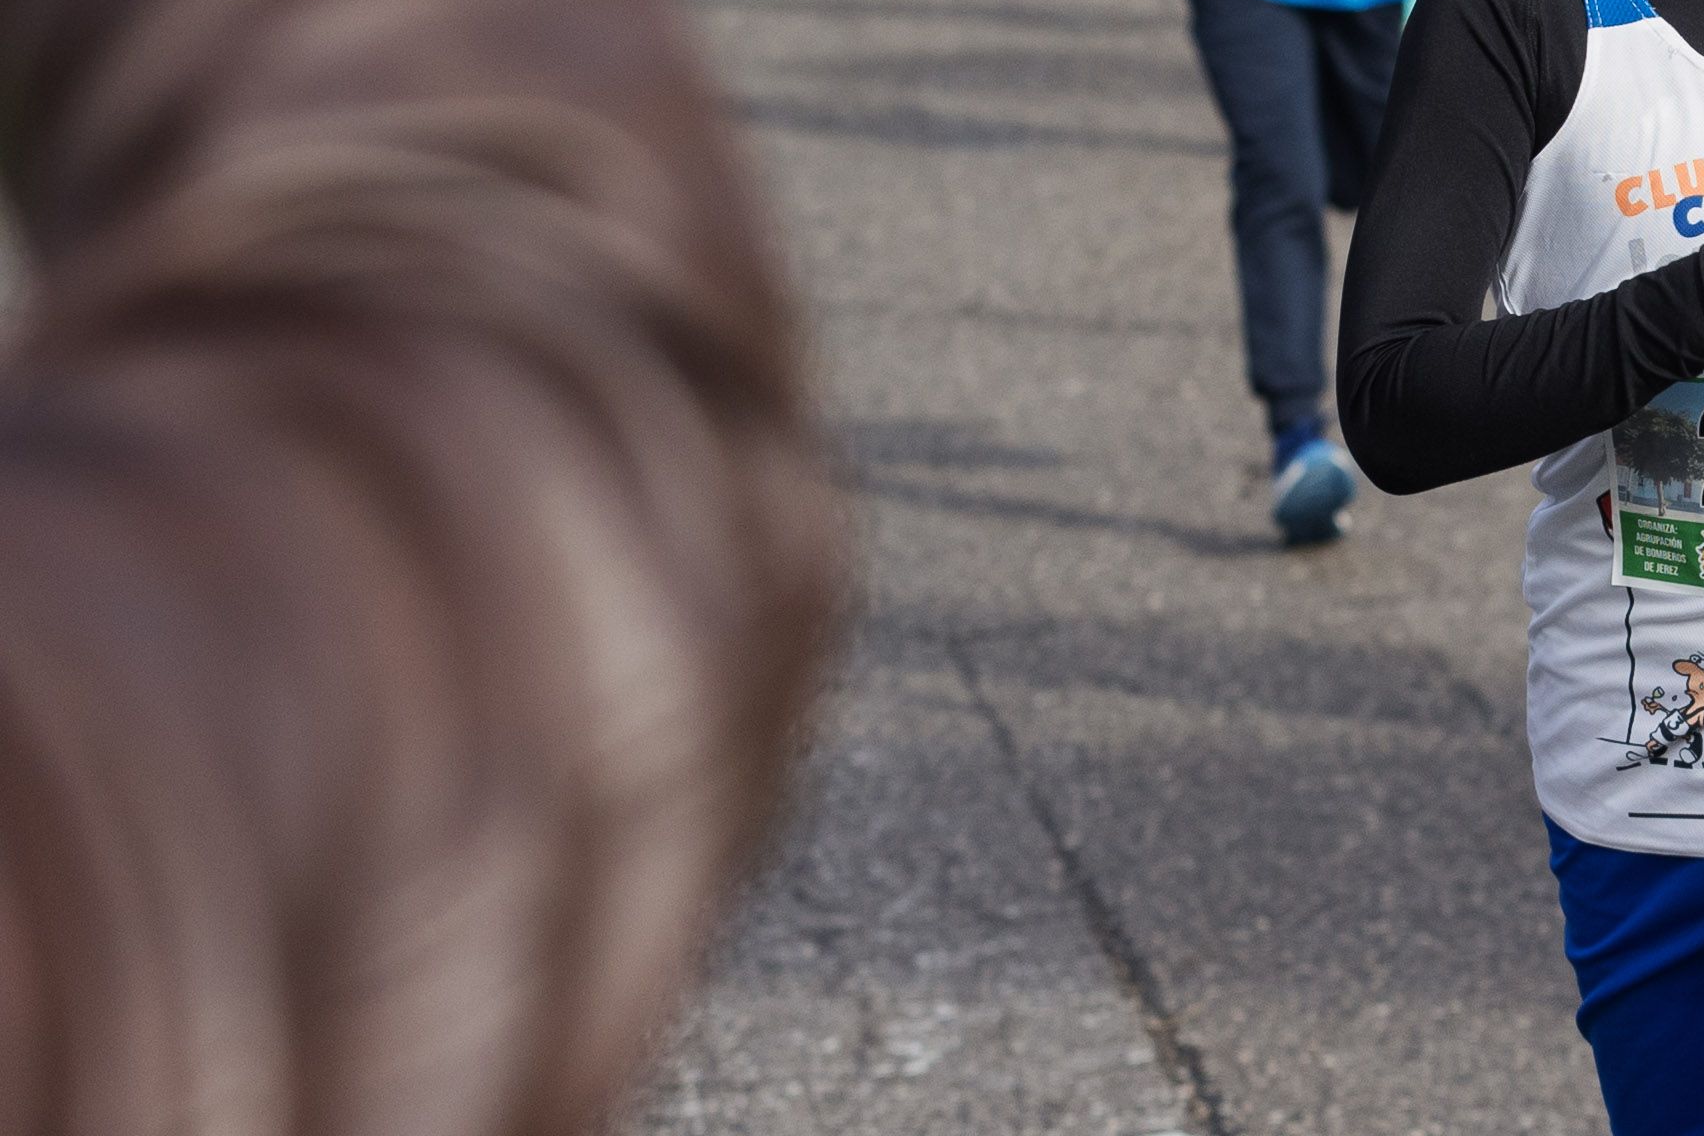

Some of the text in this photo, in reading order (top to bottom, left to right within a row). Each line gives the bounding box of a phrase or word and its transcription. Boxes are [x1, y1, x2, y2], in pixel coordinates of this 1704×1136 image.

[1634, 546, 1687, 563] DE BOMBEROS
[1644, 561, 1680, 576] DE JEREZ
